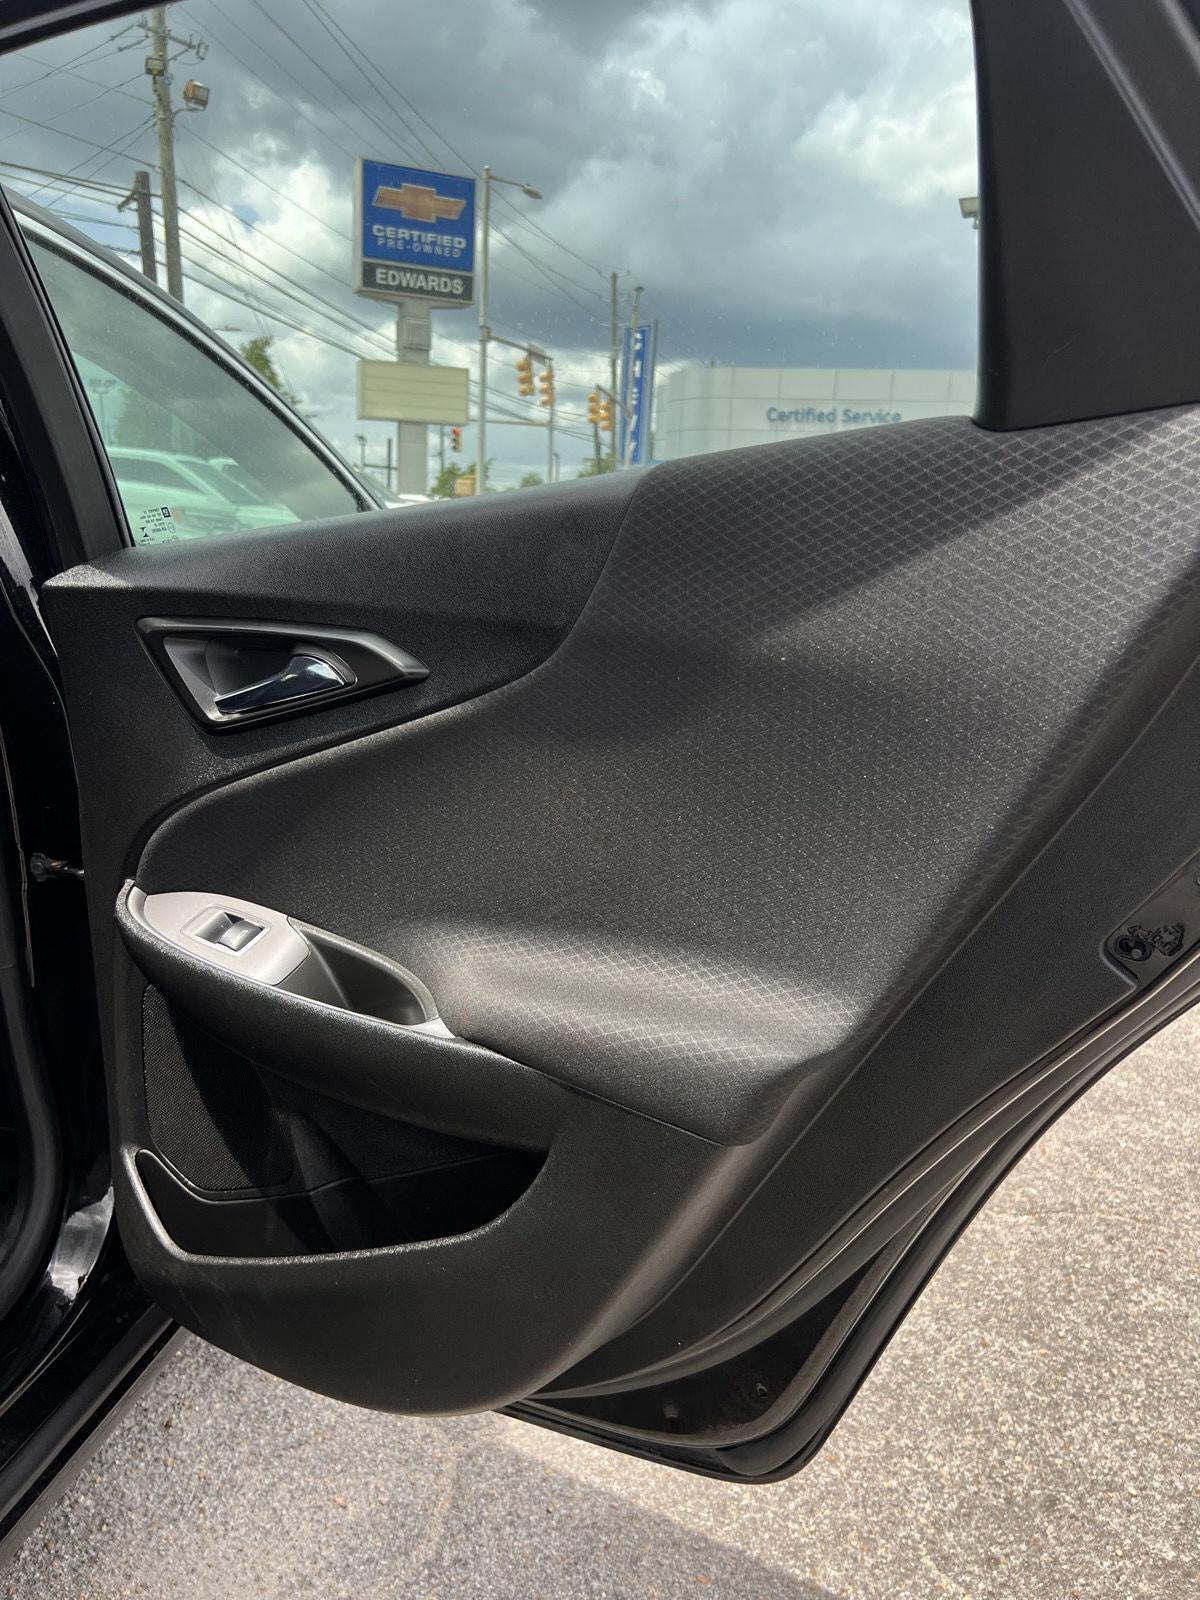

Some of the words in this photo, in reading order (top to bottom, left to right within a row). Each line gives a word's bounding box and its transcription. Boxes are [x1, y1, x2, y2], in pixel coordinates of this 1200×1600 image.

[372, 225, 467, 249] CERTIFIED
[377, 237, 462, 258] PRE-OWNED
[375, 268, 465, 295] EDWARDS
[767, 407, 836, 423] Certified
[842, 409, 902, 423] Service
